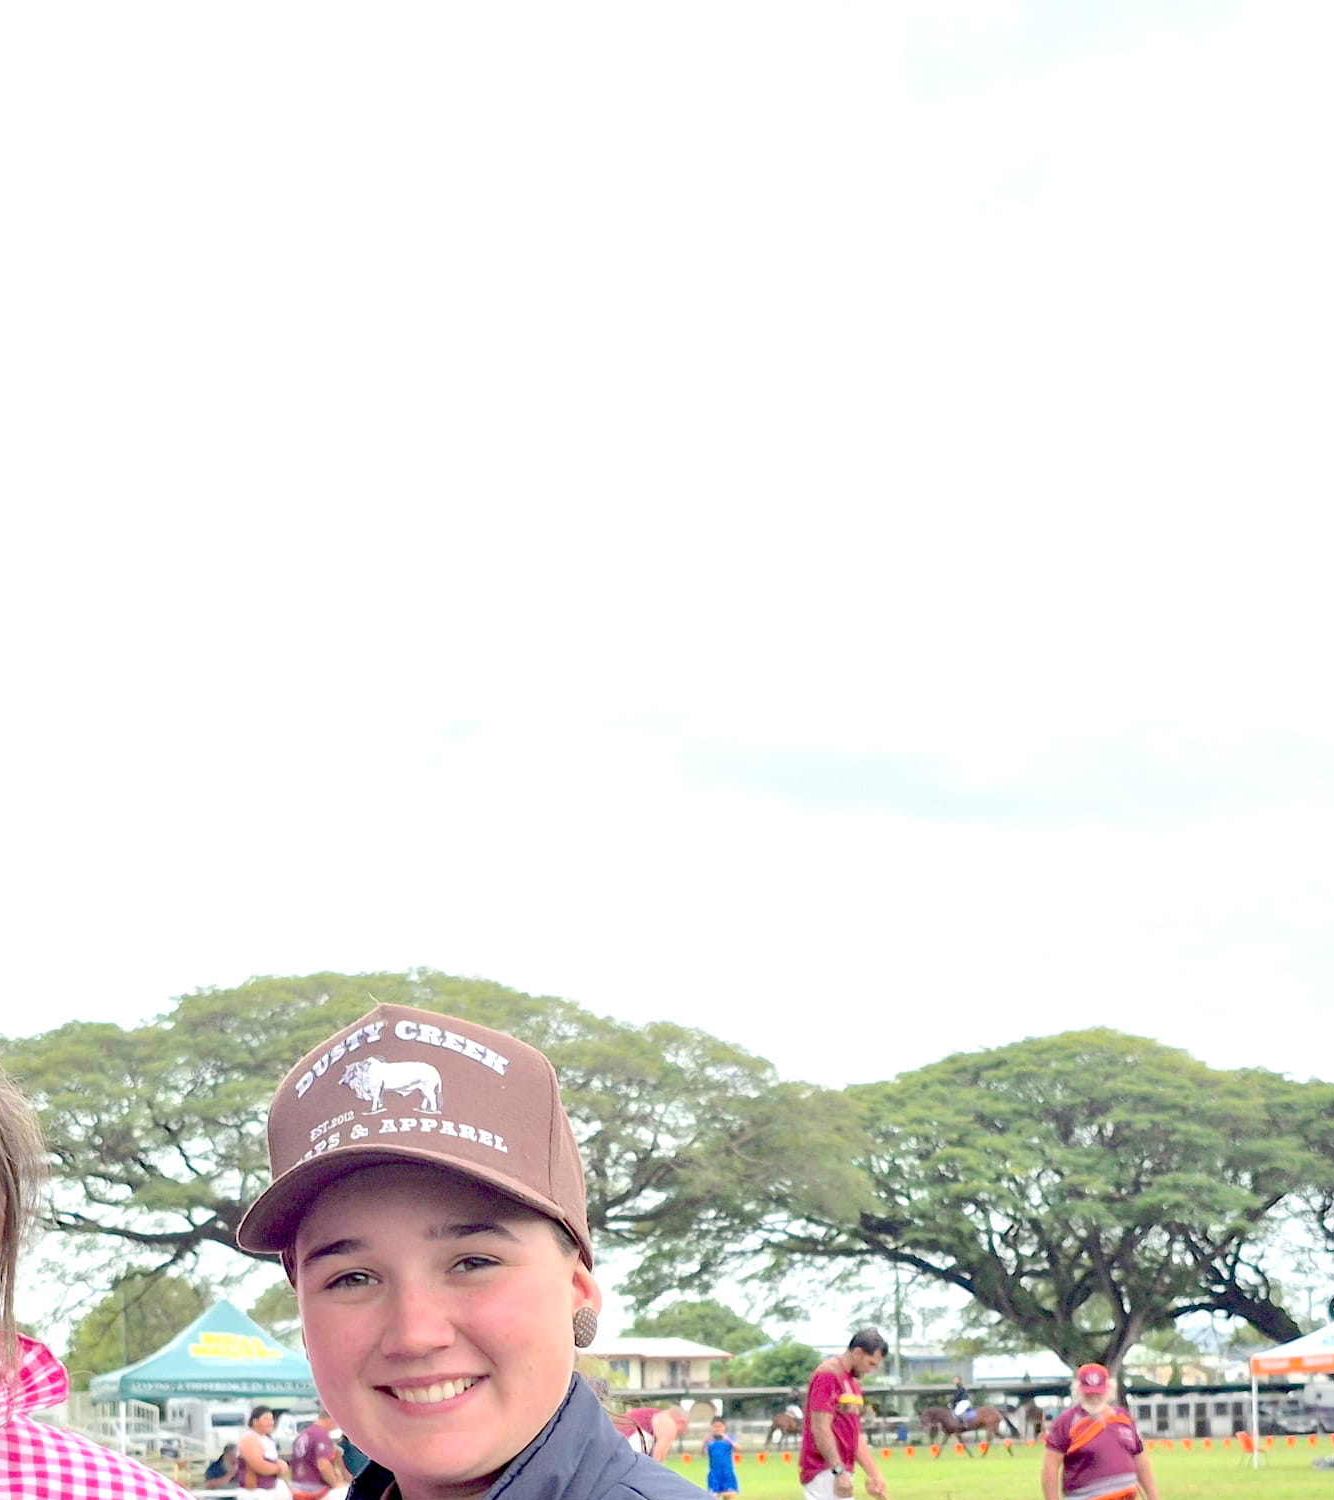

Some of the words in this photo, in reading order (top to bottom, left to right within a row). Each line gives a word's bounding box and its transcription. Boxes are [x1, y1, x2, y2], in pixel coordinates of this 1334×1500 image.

[294, 1021, 385, 1099] DUSTY
[394, 1020, 511, 1076] CREEK
[296, 1132, 341, 1164] APS
[350, 1123, 369, 1140] &
[378, 1118, 509, 1153] APPAREL
